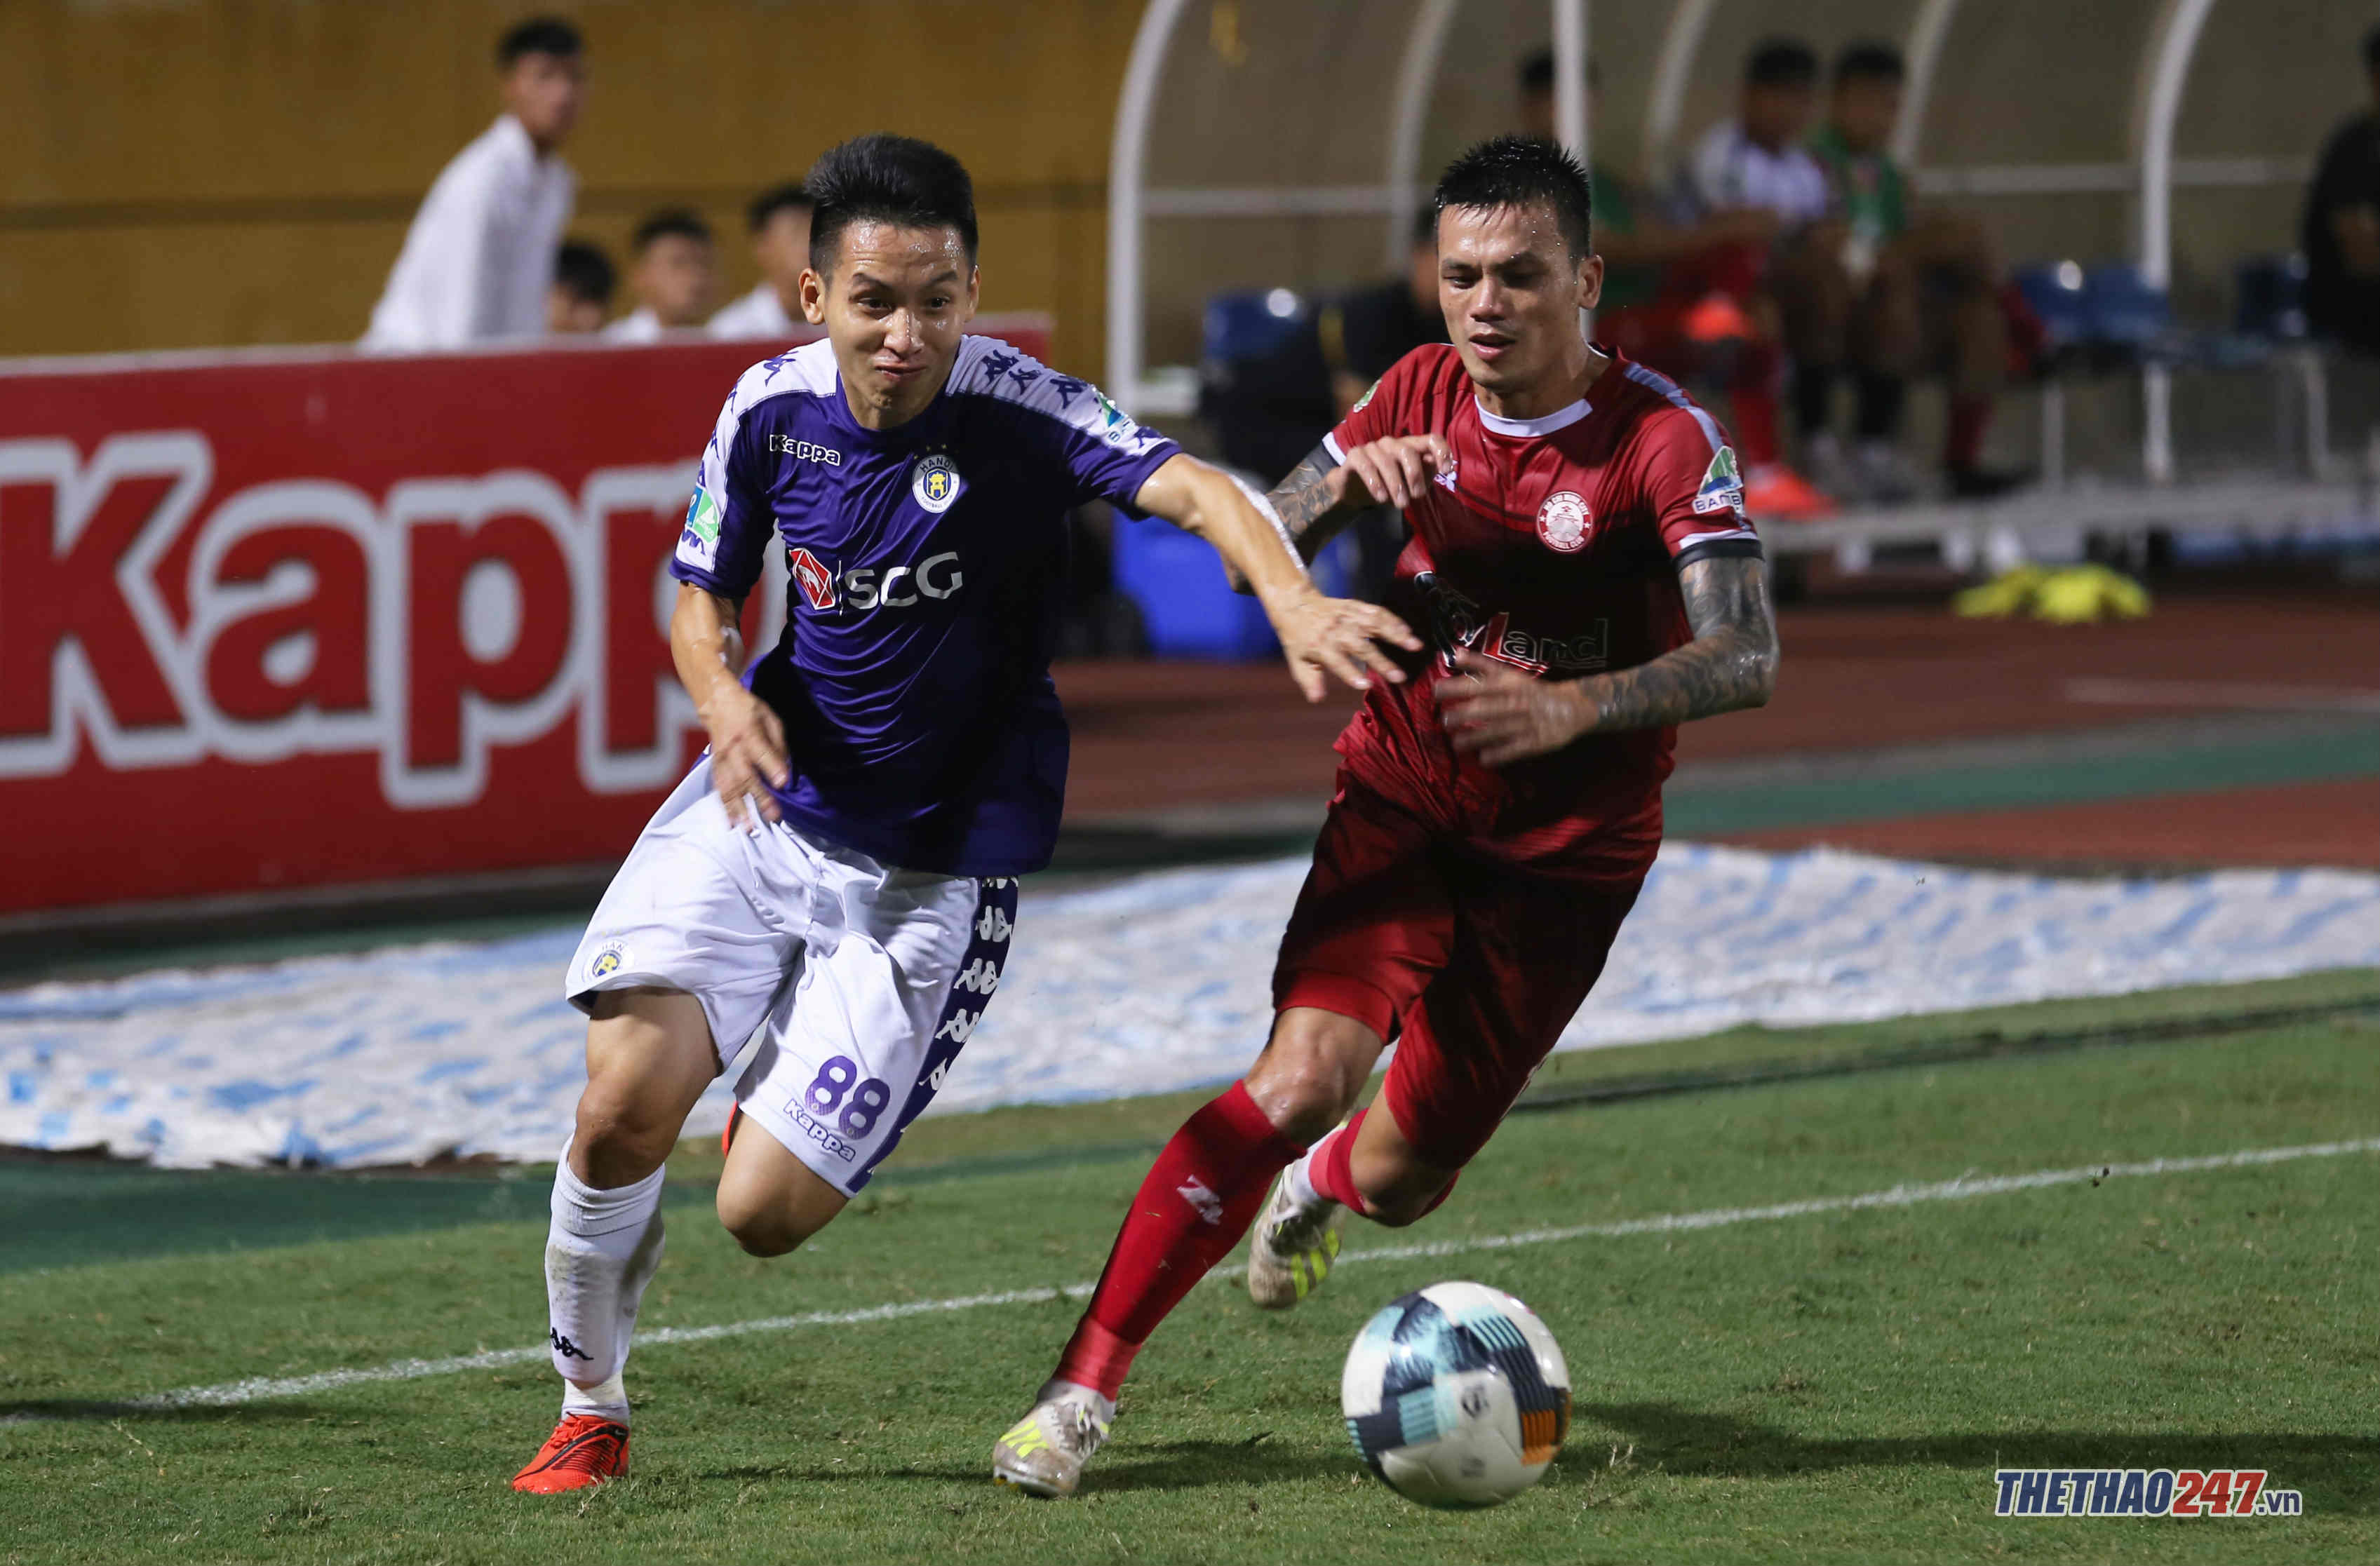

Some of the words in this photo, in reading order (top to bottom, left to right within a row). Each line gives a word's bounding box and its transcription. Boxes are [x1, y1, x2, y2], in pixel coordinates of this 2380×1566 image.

[769, 434, 840, 466] Kappa
[920, 457, 954, 473] HANOI
[845, 551, 963, 609] SCG
[0, 429, 787, 809] Kapp
[805, 1055, 890, 1140] 88
[784, 1098, 856, 1162] Kappa
